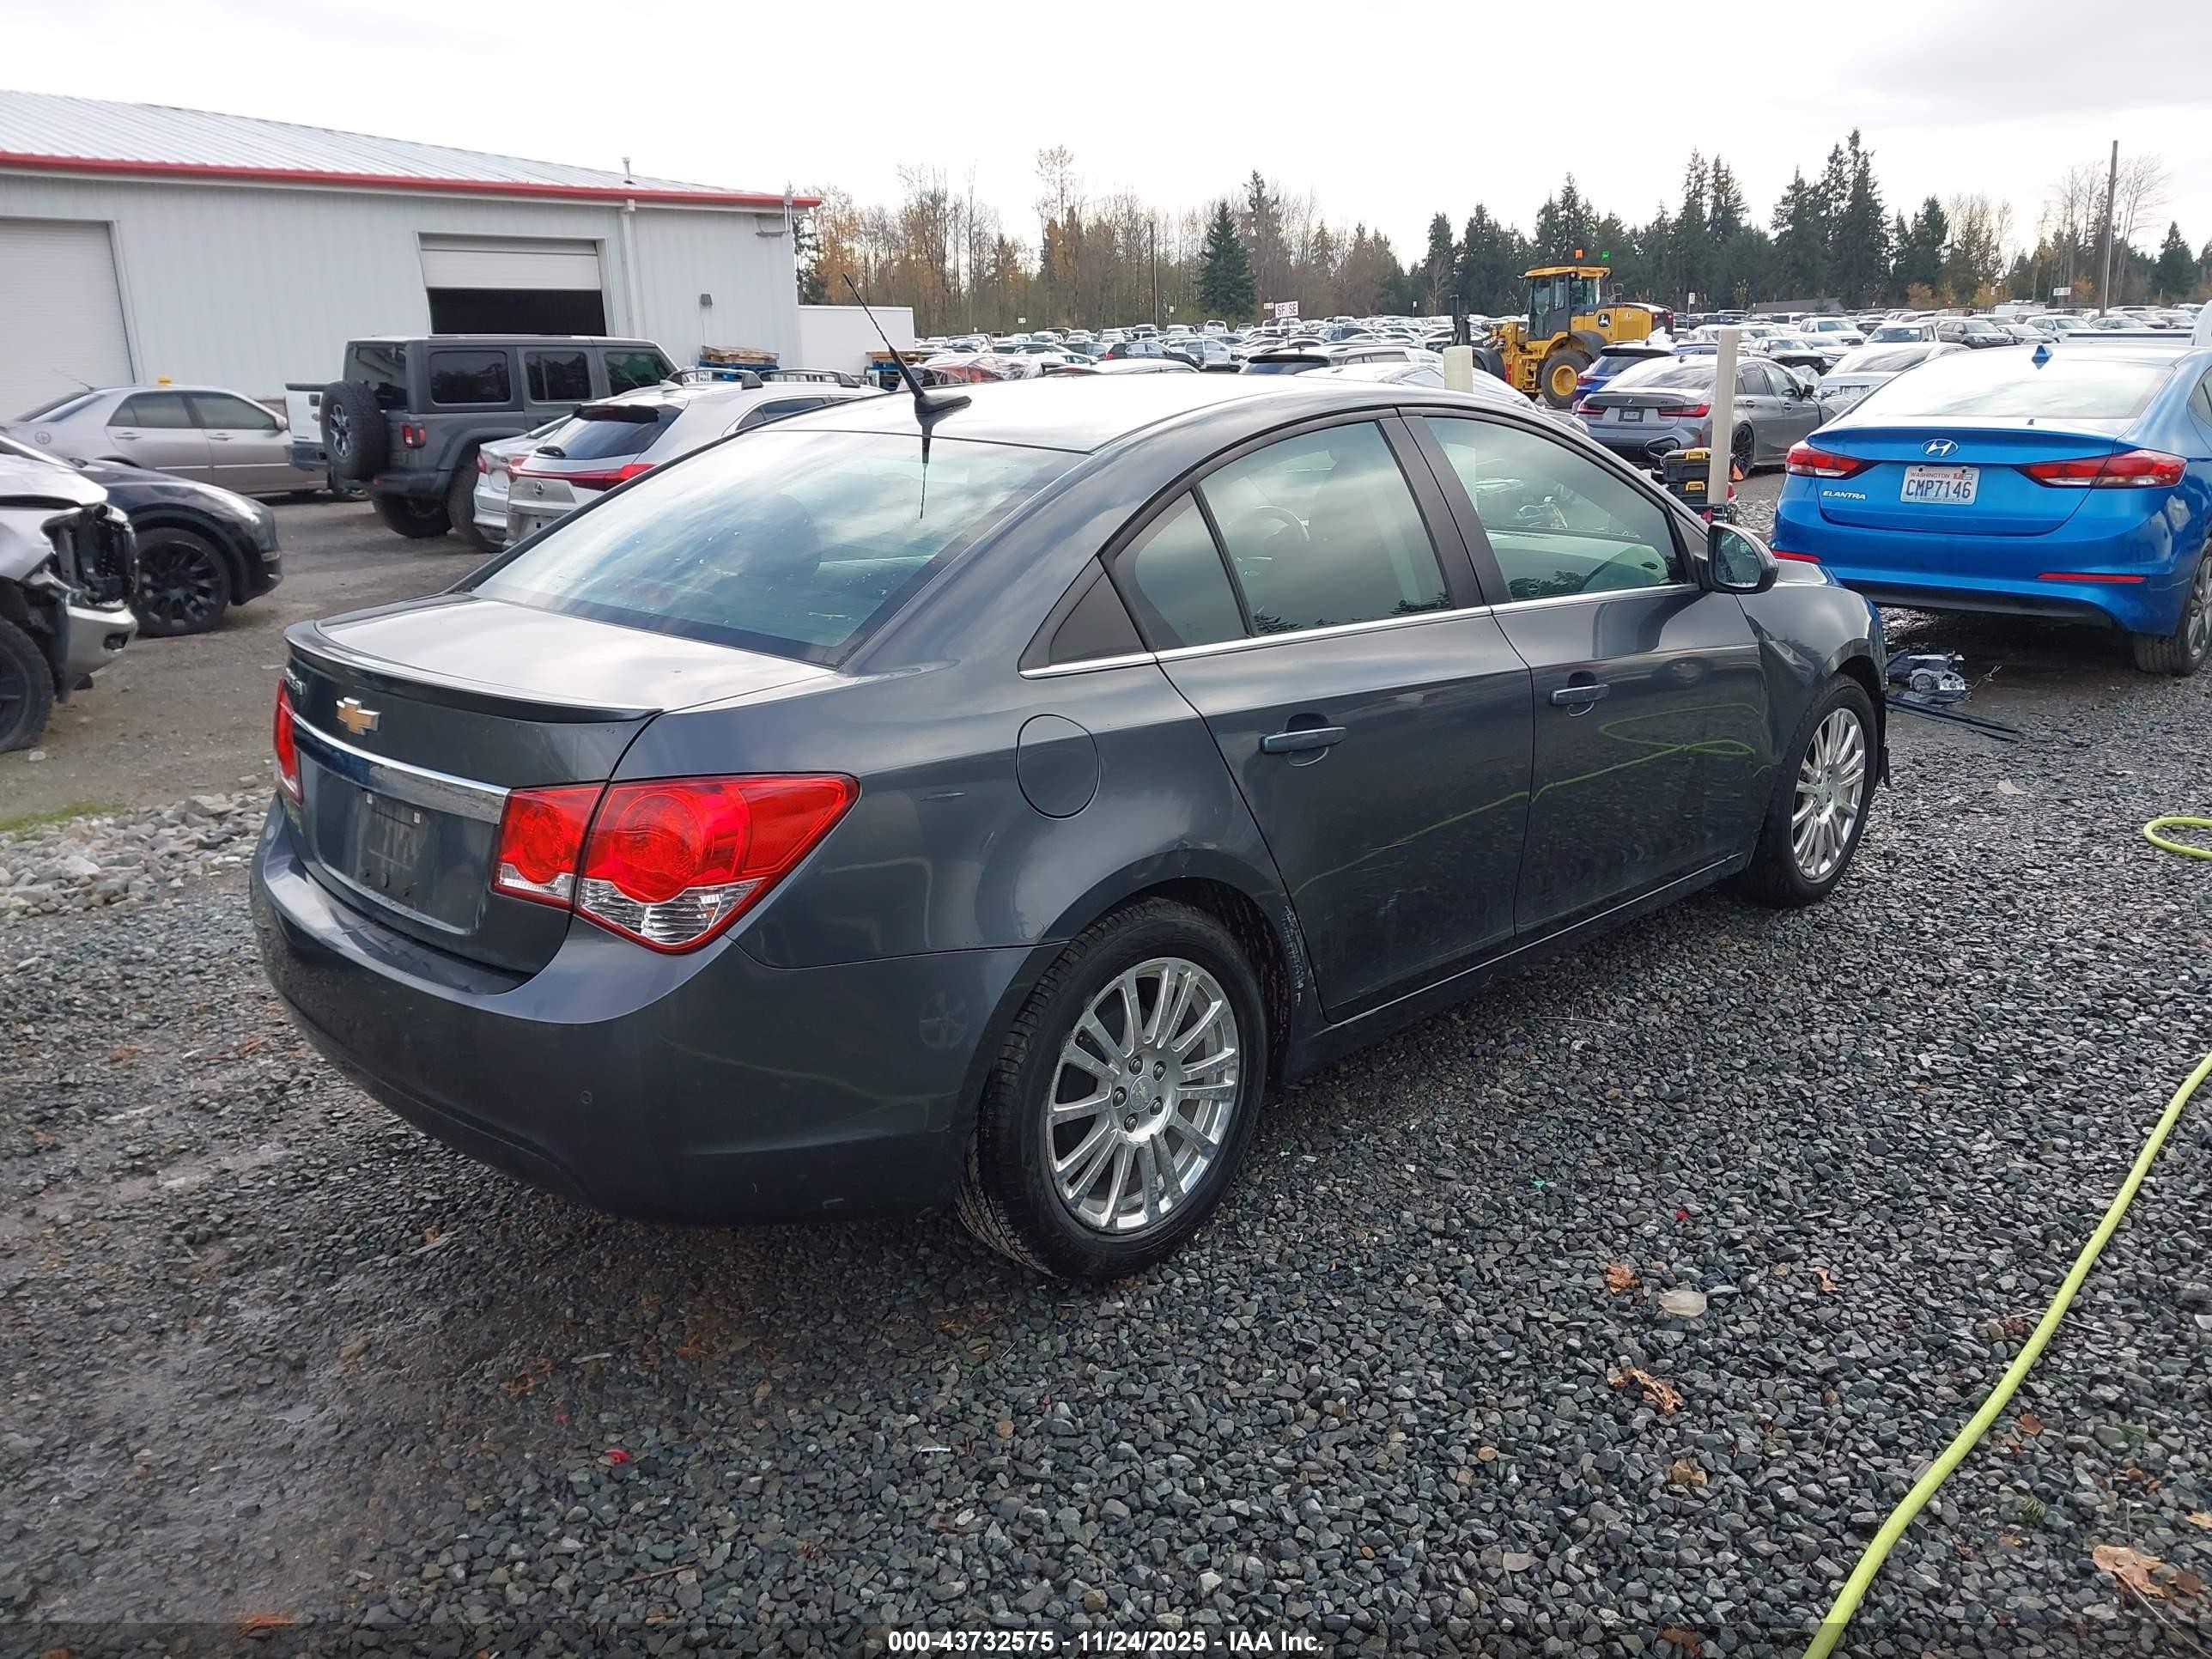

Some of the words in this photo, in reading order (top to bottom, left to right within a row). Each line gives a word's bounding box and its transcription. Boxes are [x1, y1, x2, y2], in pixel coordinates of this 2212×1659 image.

[1288, 303, 1297, 314] SE
[1905, 479, 1972, 498] CMP7146
[1822, 490, 1866, 500] ELANTRA
